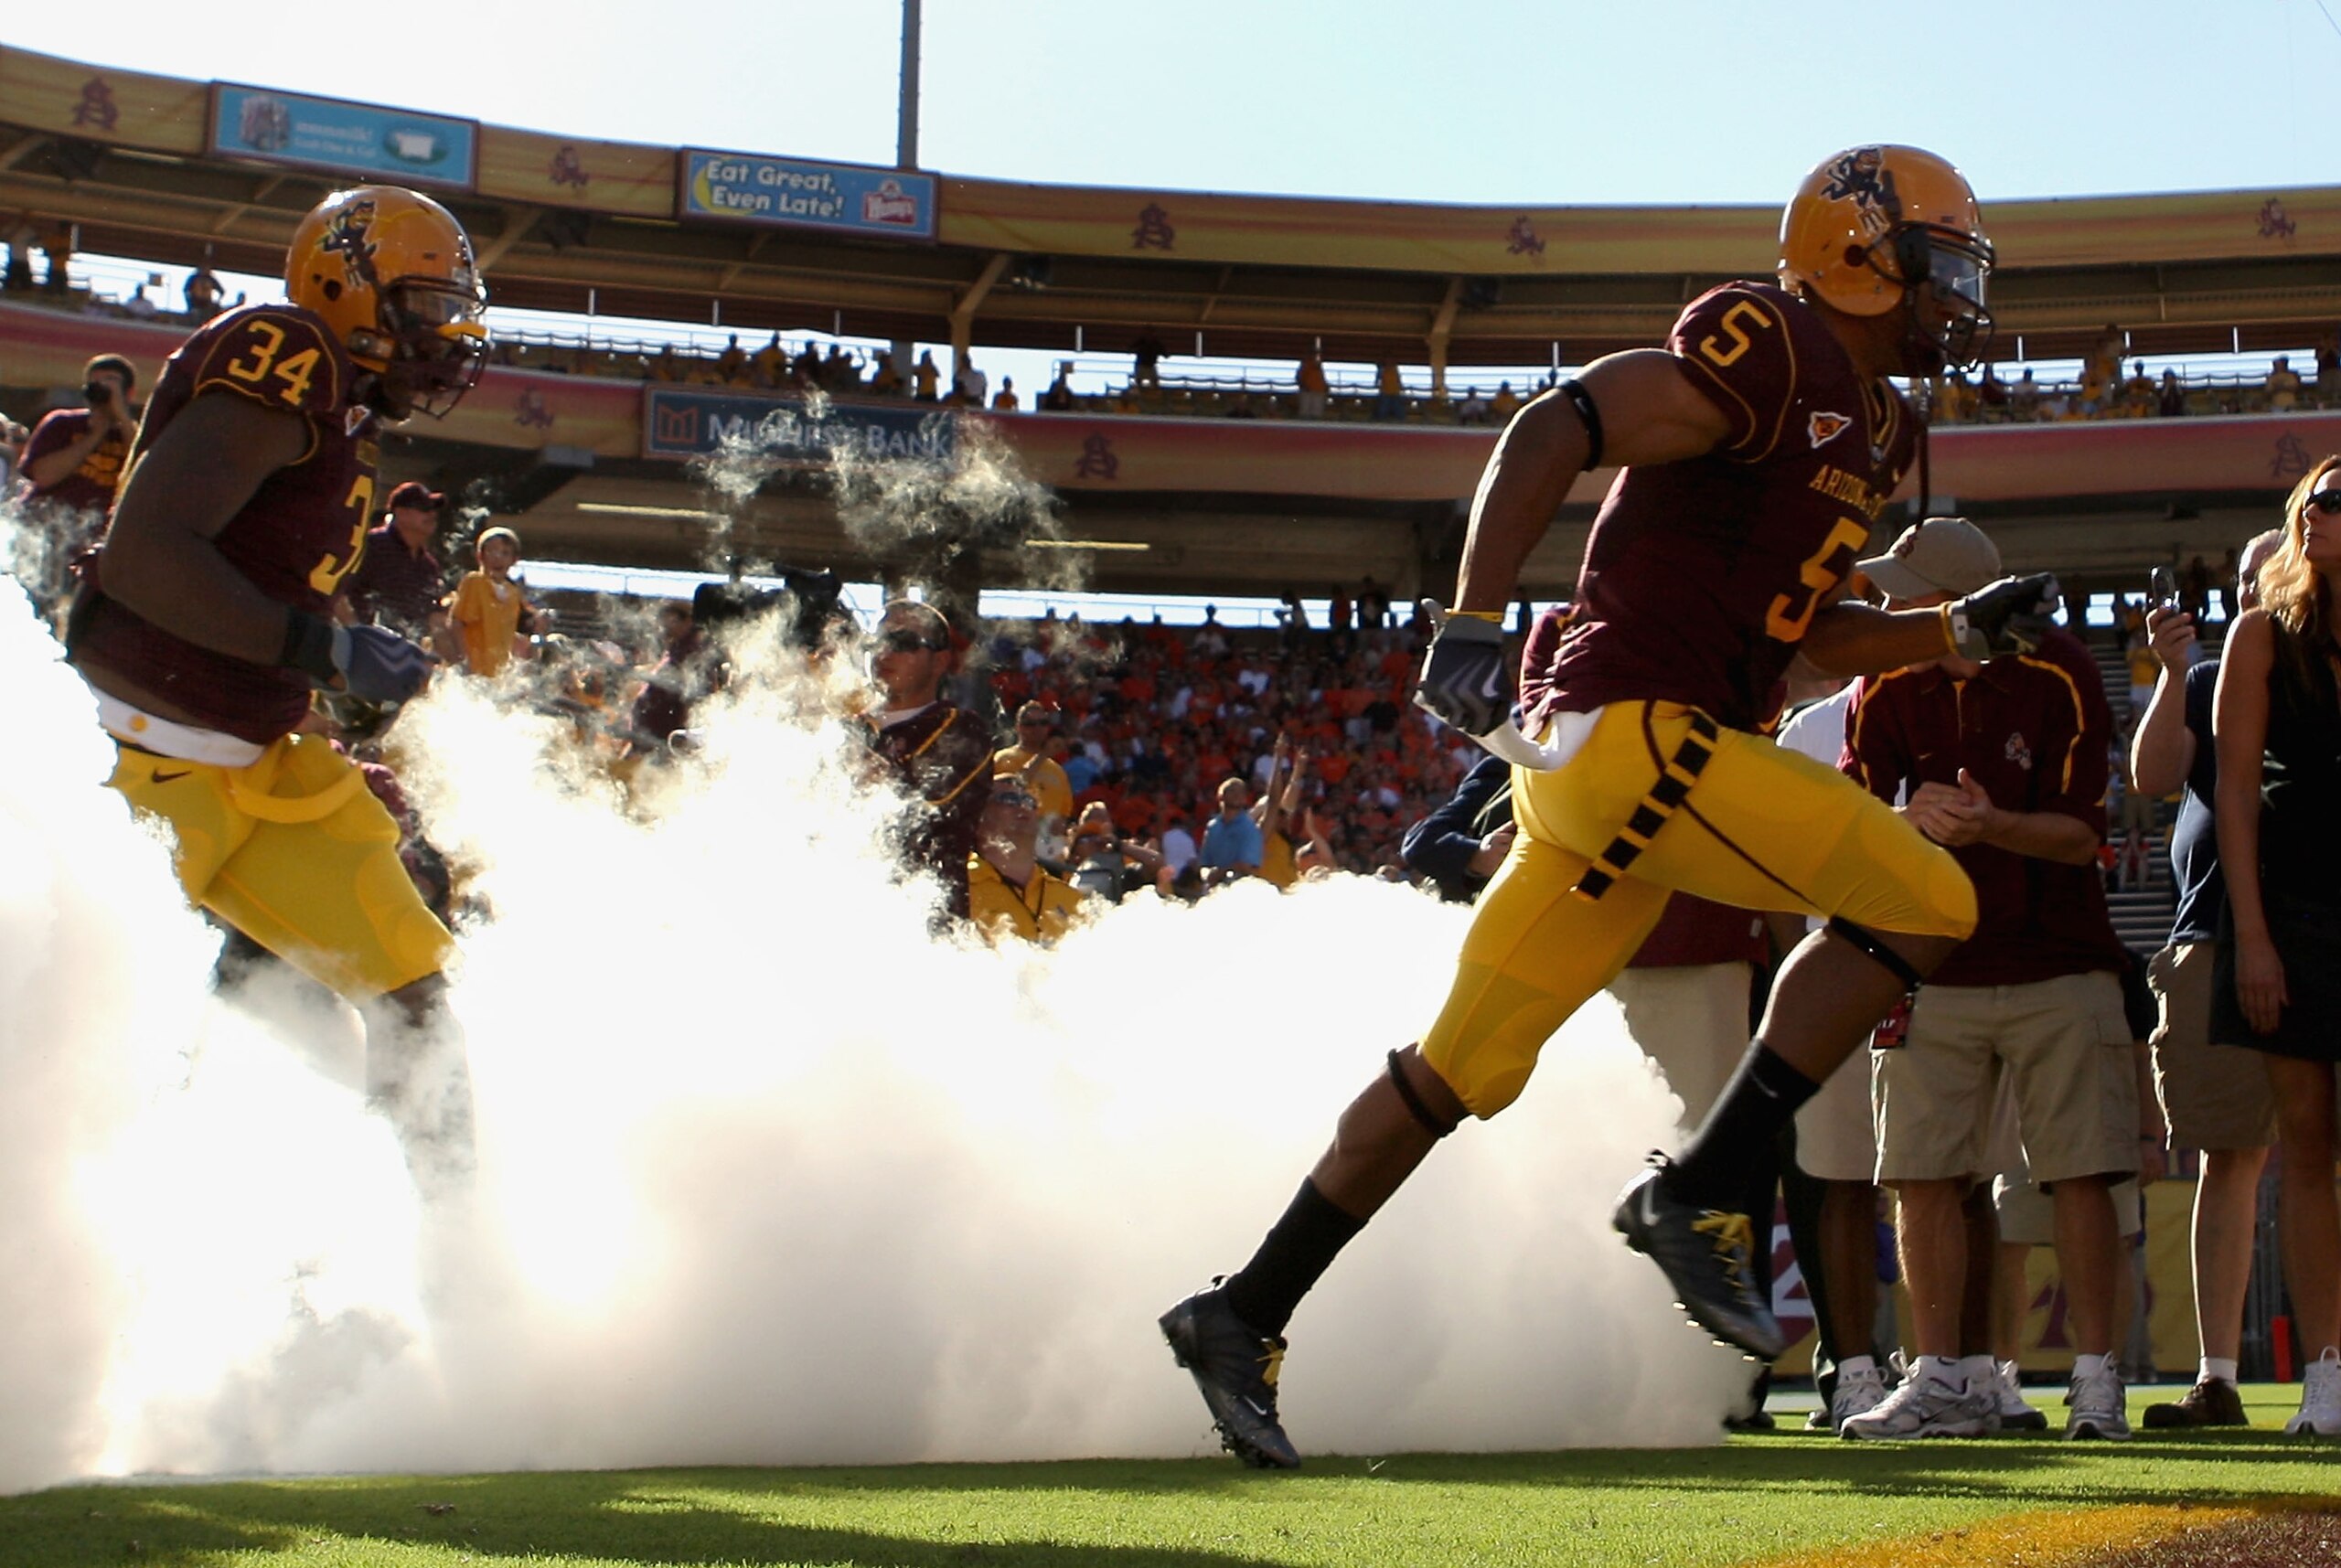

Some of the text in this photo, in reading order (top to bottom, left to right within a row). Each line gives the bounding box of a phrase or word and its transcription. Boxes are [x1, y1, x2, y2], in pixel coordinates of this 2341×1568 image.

[707, 159, 837, 195] Eat Great,
[711, 186, 844, 218] Even Late!
[228, 319, 321, 407] 34
[1700, 300, 1772, 367] 5
[308, 474, 374, 596] 3
[1765, 516, 1869, 644] 5
